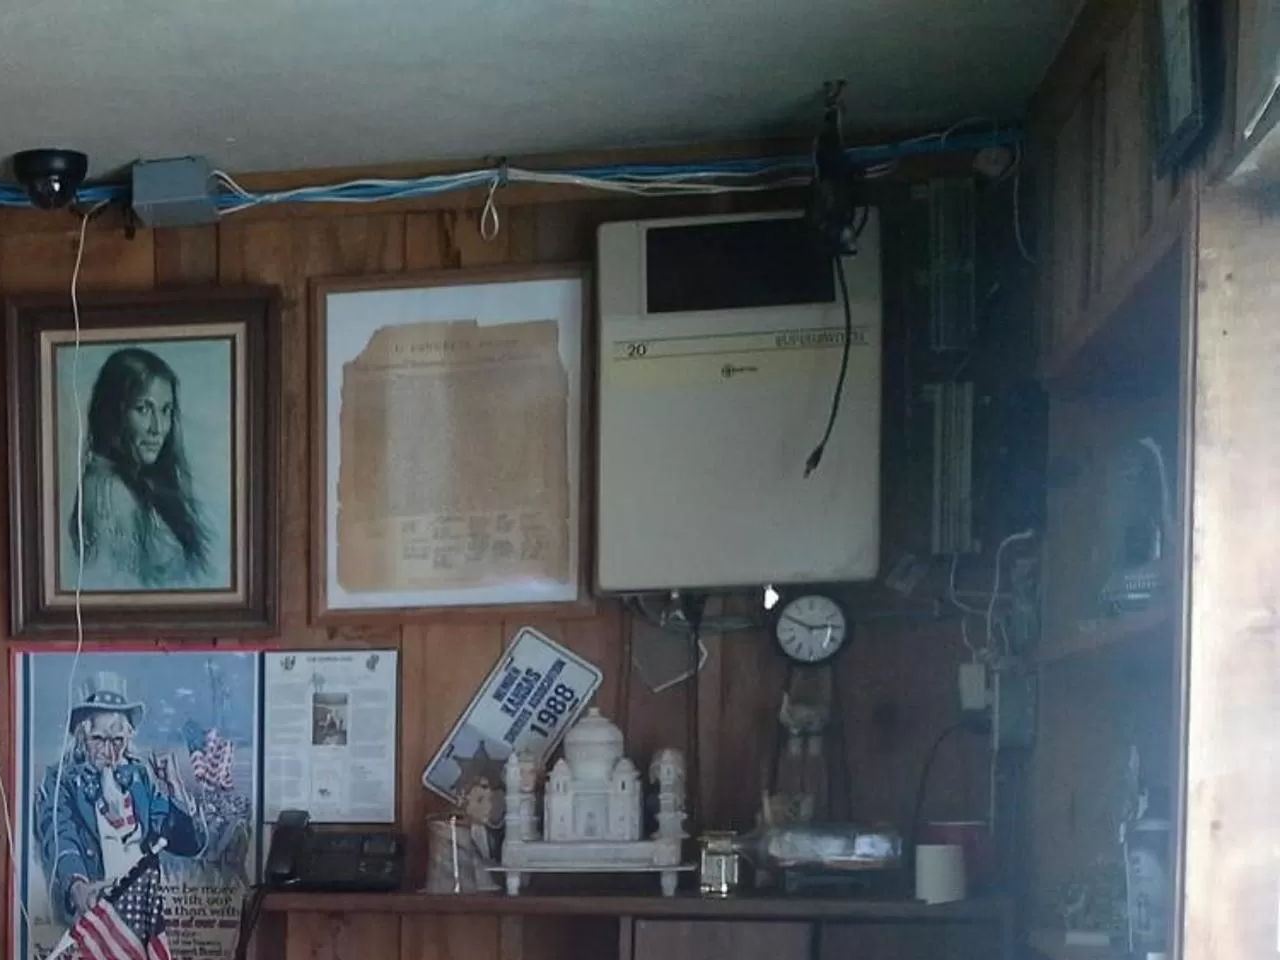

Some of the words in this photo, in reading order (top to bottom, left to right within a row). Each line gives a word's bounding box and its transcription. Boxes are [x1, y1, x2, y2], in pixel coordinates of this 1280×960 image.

[500, 667, 542, 718] KANSAS
[530, 684, 575, 738] 1988
[175, 905, 206, 916] than
